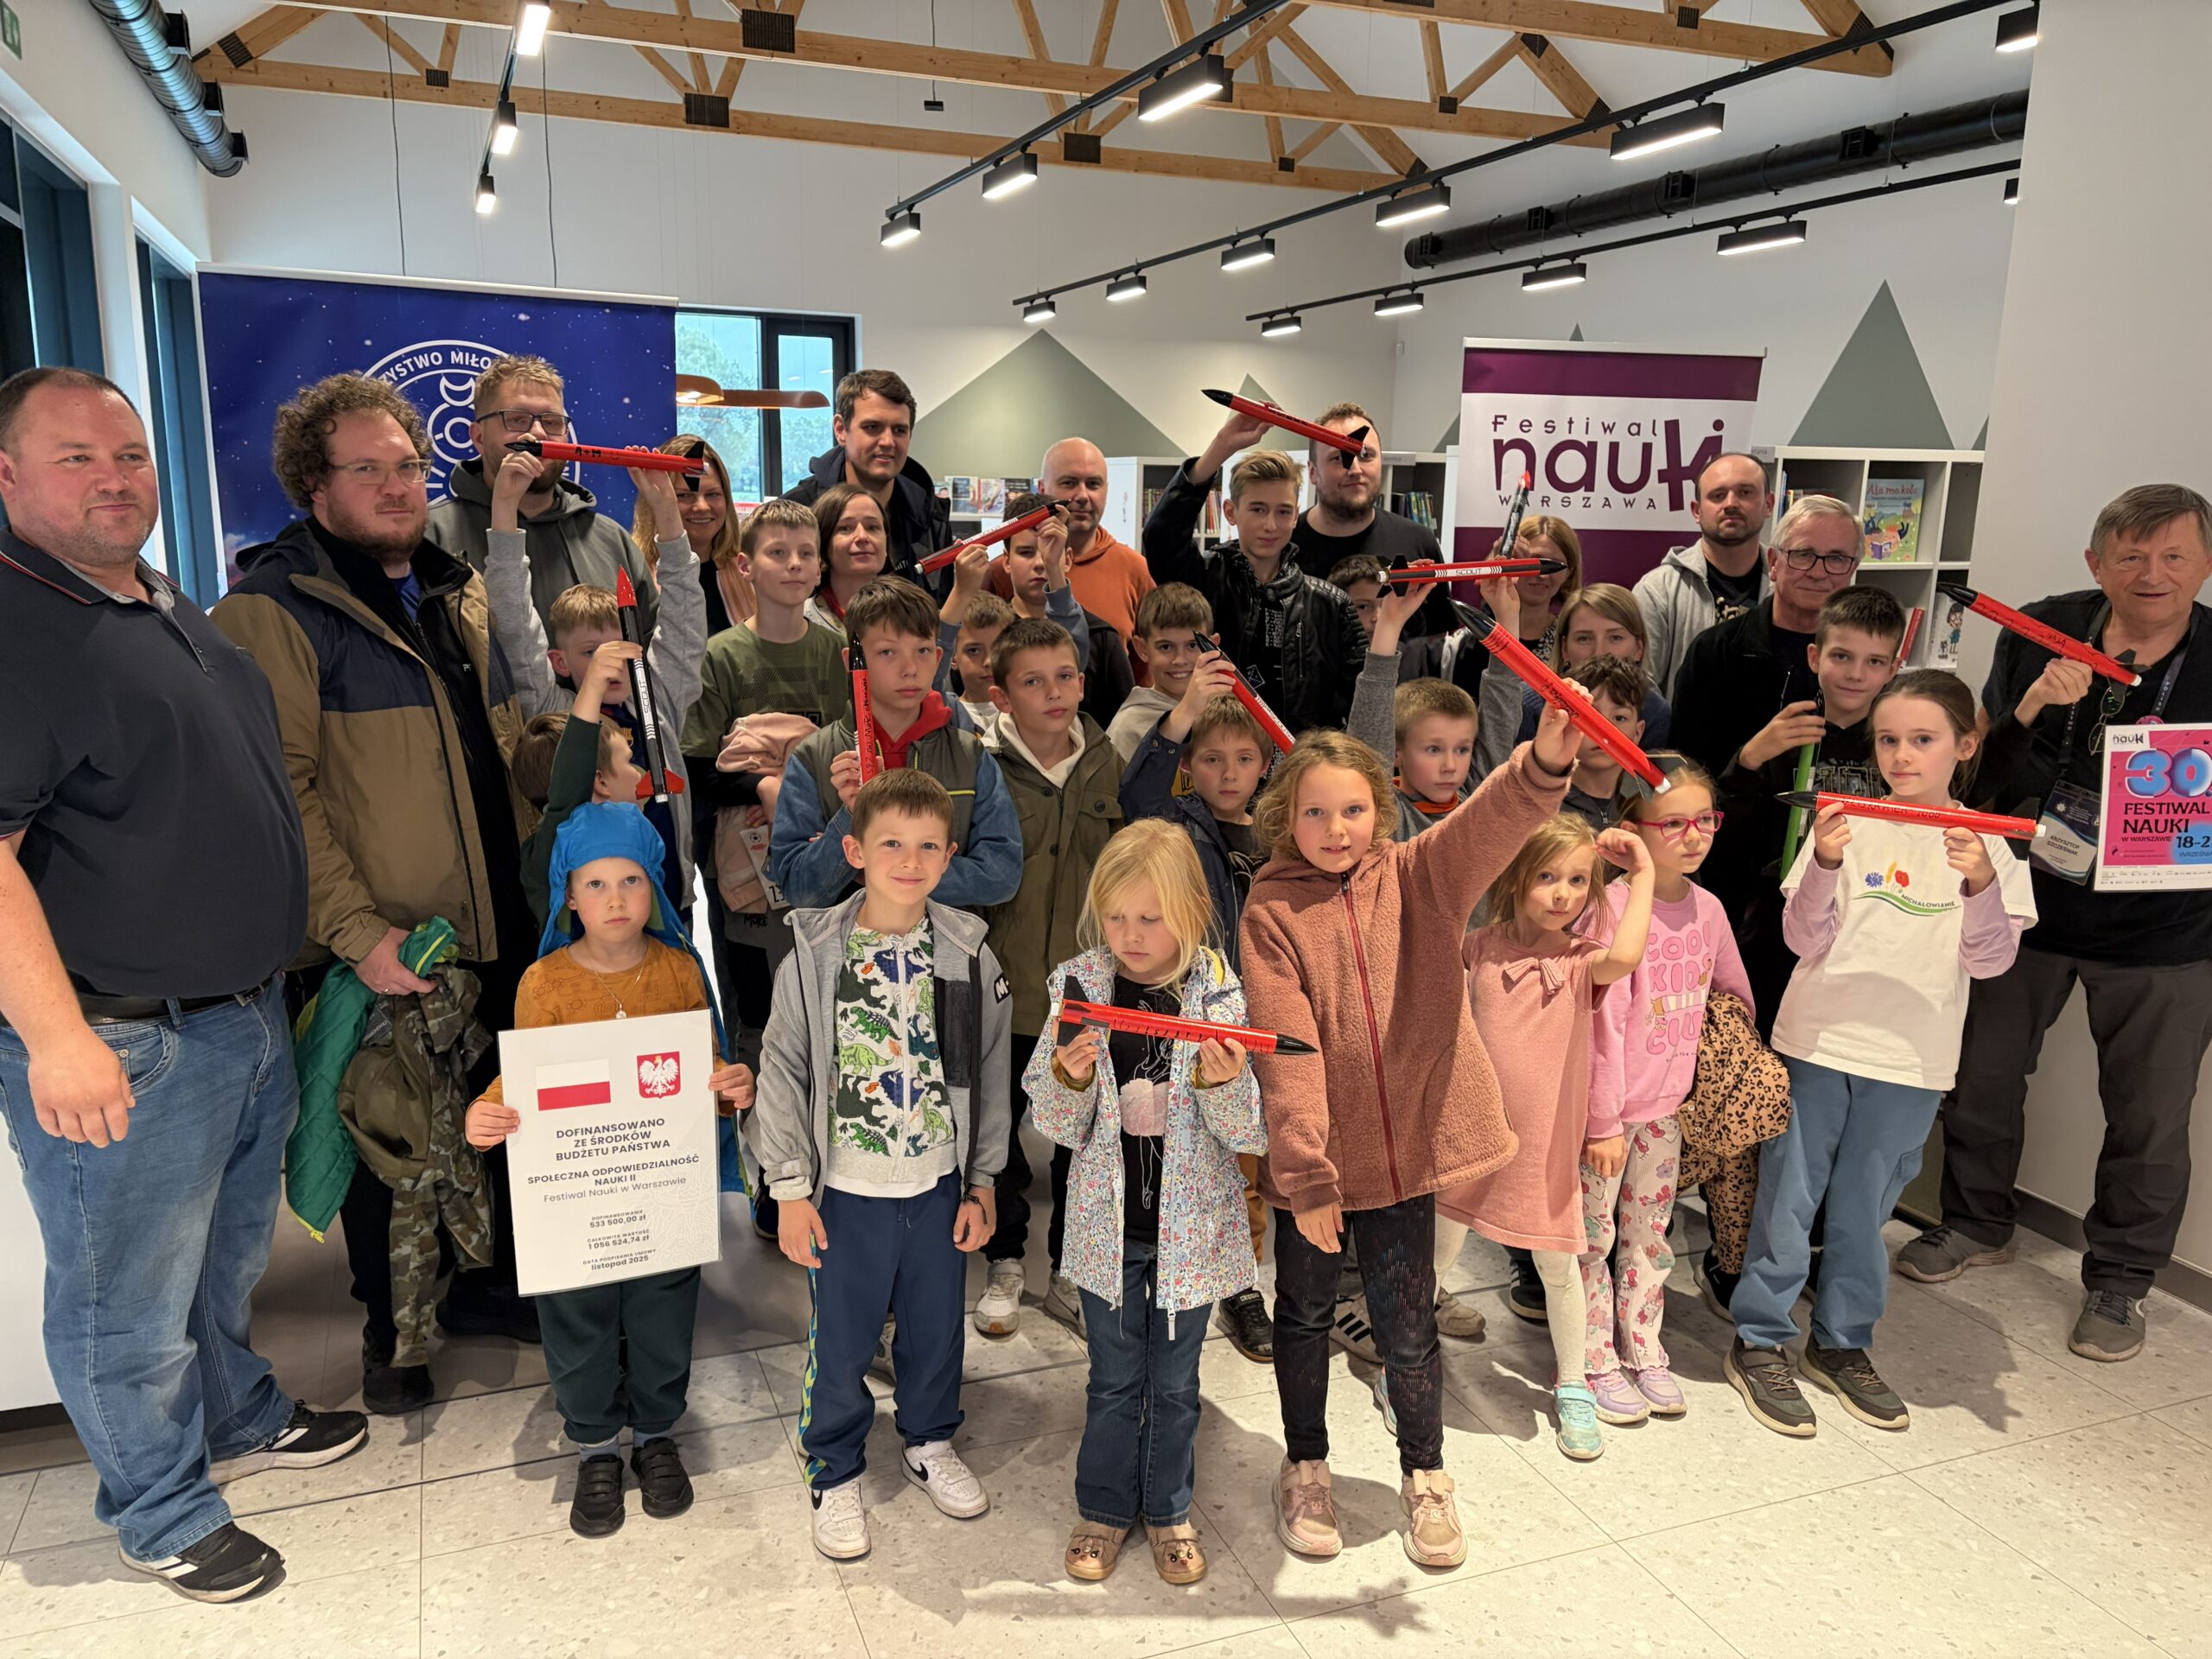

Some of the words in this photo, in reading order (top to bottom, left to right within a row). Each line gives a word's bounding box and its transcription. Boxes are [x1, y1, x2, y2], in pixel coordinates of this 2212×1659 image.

[450, 350, 492, 370] MIŁO
[1491, 415, 1657, 436] Festiwal
[1455, 568, 1483, 576] SCOUT
[2124, 802, 2210, 815] FESTIWAL
[2122, 819, 2190, 834] NAUKI
[2176, 836, 2212, 849] 18-2
[1646, 1011, 1705, 1055] CLU
[556, 1117, 665, 1139] DOFINANSOWANO
[574, 1139, 588, 1147] ZE
[590, 1130, 652, 1146] ŚRODKÓW
[556, 1147, 608, 1161] BUDŻETU
[612, 1139, 671, 1154] PAŃSTWA
[528, 1170, 589, 1185] SPOŁECZNA
[592, 1154, 700, 1177] ODPOWIEDZIALNOŚĆ
[594, 1175, 627, 1186] NAUKI
[543, 1191, 586, 1203] Festiwal
[588, 1186, 618, 1197] Nauki
[632, 1176, 686, 1192] Warszawie
[589, 1220, 605, 1229] 533
[607, 1216, 637, 1226] 500,00
[591, 1210, 643, 1221] DOFINANSOWANIE
[612, 1236, 640, 1246] 524,74
[591, 1258, 627, 1271] listopad
[628, 1255, 649, 1264] 2025
